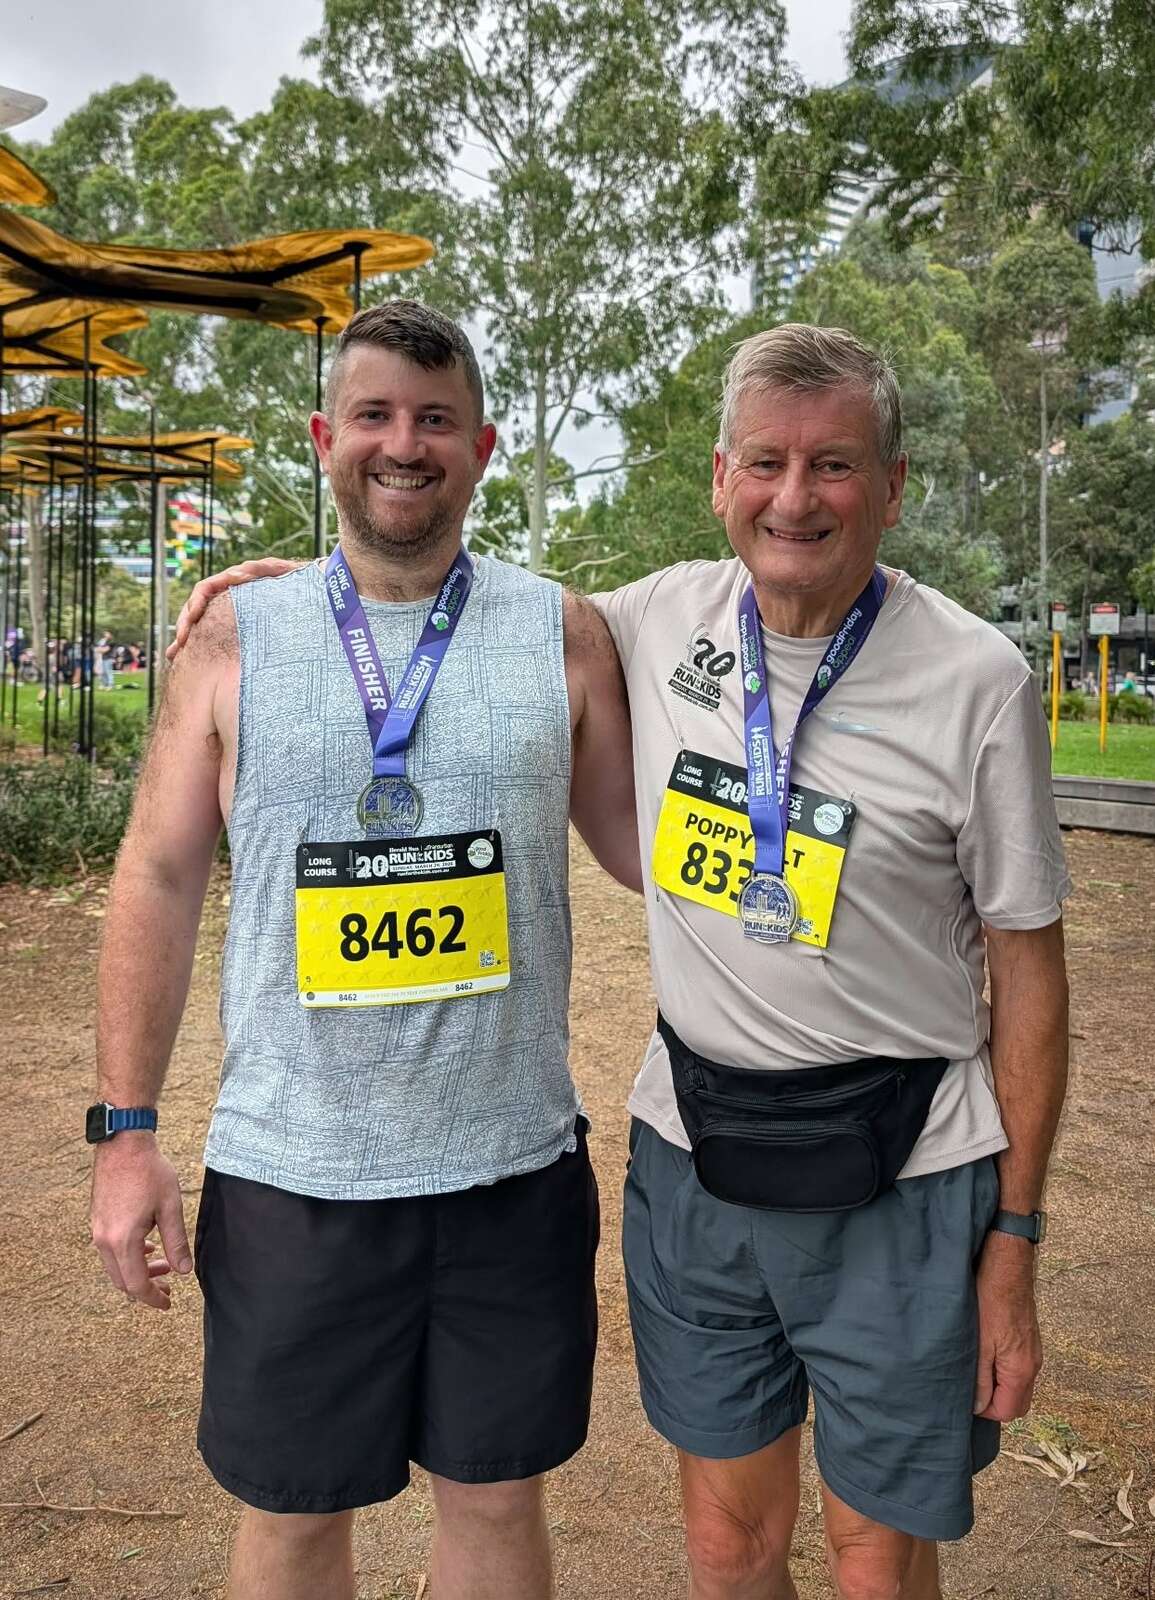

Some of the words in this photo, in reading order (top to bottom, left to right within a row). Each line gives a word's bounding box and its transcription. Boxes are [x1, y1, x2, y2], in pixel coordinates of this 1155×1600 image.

[335, 563, 350, 590] LONG
[329, 575, 345, 611] COURSE
[347, 628, 388, 711] FINISHER
[694, 638, 736, 680] 20
[673, 667, 697, 687] RUN
[398, 689, 414, 708] RUN
[676, 773, 703, 787] COURSE
[683, 764, 702, 776] LONG
[715, 777, 746, 804] 20
[755, 770, 765, 796] RUN
[685, 812, 754, 850] POPPY
[308, 858, 332, 866] LONG
[355, 854, 389, 878] 20
[389, 853, 417, 864] RUN
[304, 868, 338, 876] COURSE
[340, 905, 466, 961] 8462
[745, 920, 762, 930] RUN
[338, 993, 358, 1001] 8462
[455, 982, 473, 991] 8462
